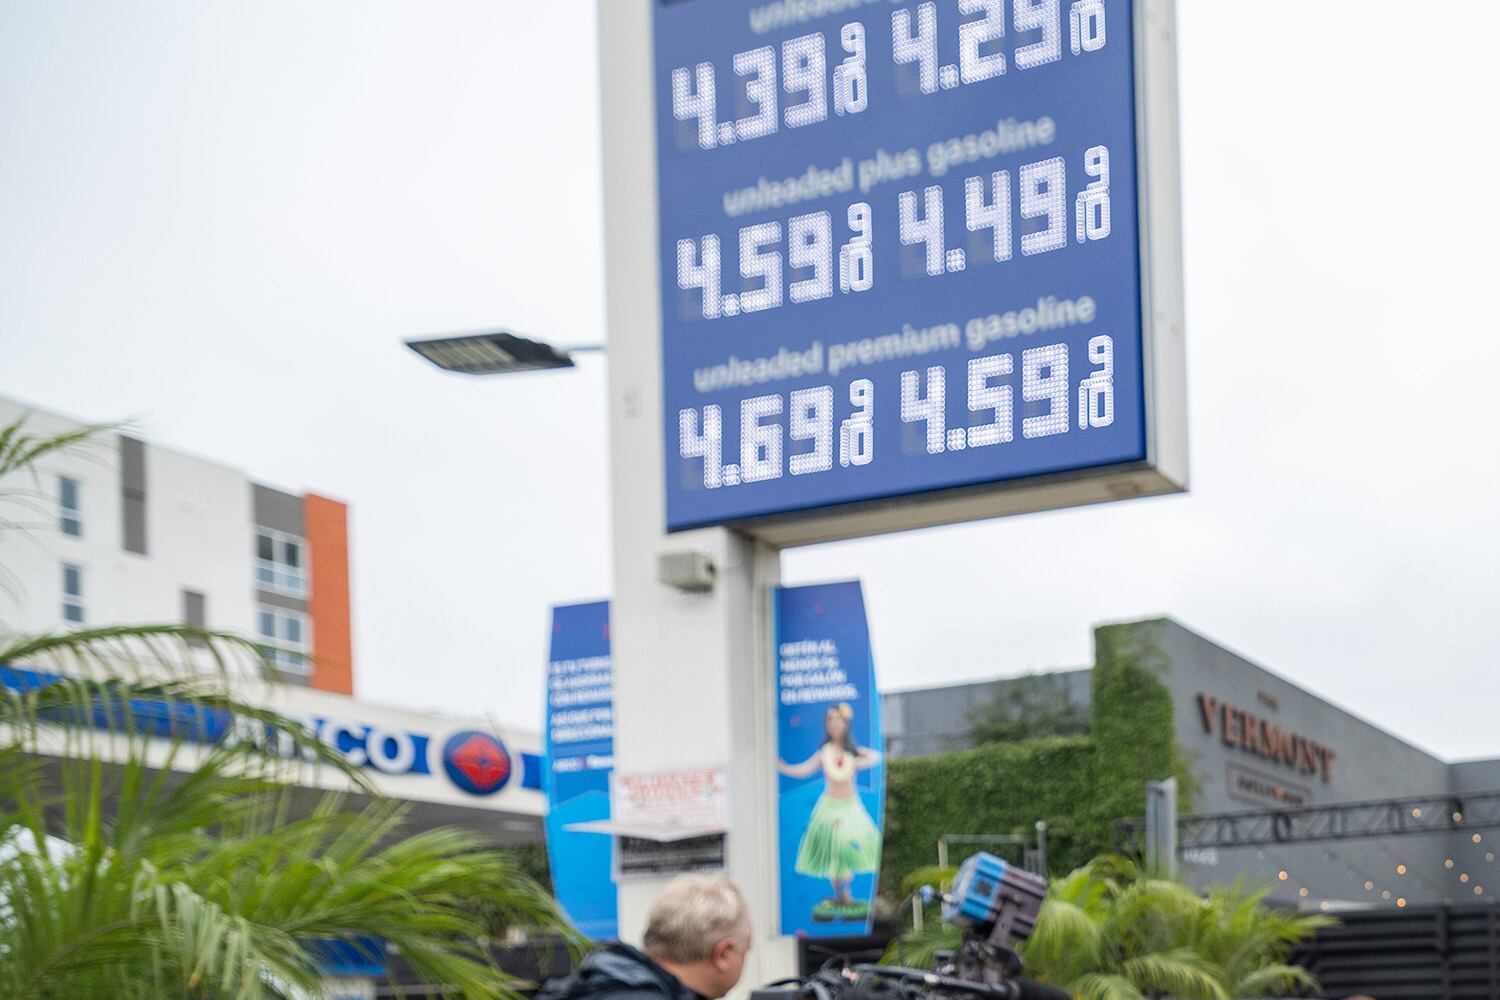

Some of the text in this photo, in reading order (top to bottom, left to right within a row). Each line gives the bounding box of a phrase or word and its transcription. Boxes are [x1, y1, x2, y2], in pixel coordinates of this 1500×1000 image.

[723, 116, 1056, 217] unleaded plus gasoline
[693, 296, 1097, 392] unleaded premium gasoline
[1197, 692, 1335, 783] VERMONT
